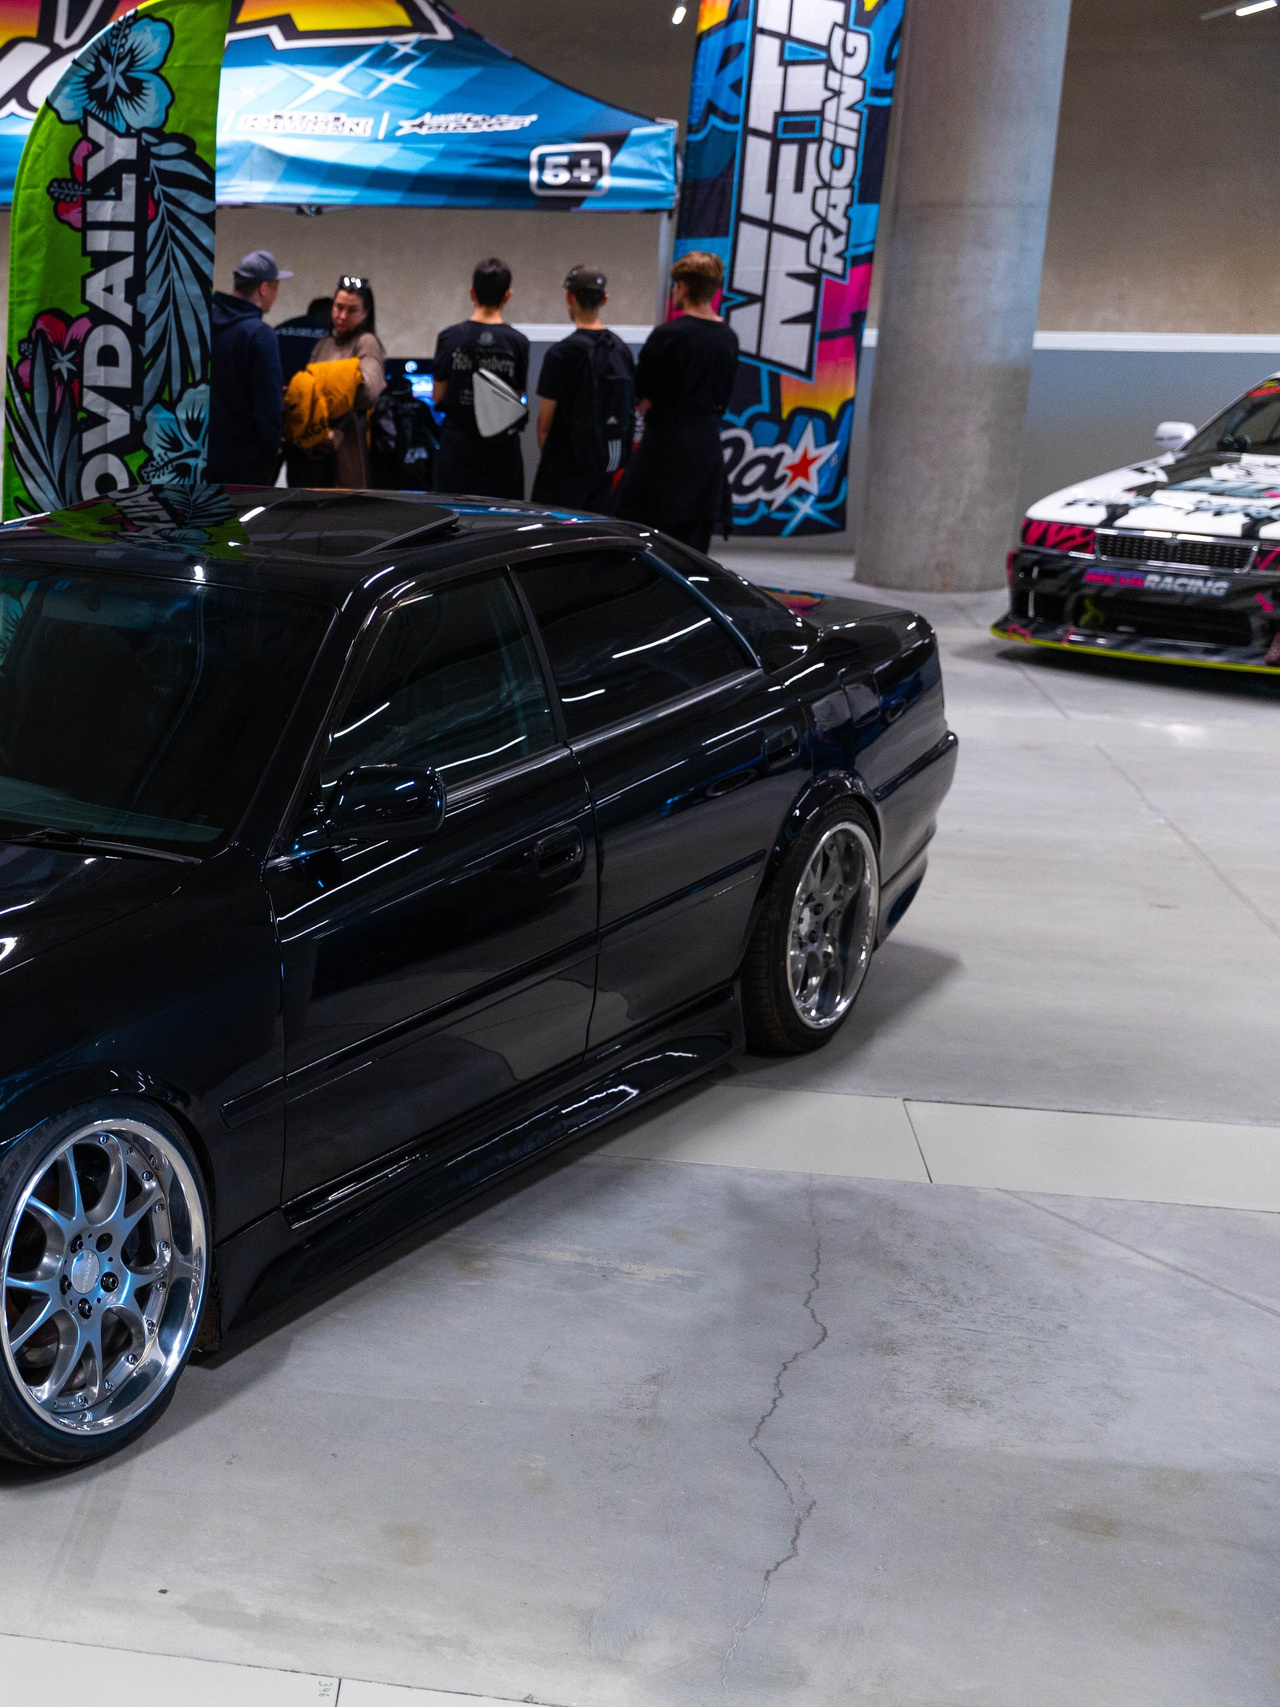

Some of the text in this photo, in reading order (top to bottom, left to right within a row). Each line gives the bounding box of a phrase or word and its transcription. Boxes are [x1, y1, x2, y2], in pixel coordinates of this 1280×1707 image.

[807, 23, 869, 278] RACING
[542, 155, 598, 186] 5+
[1144, 574, 1230, 596] RACING
